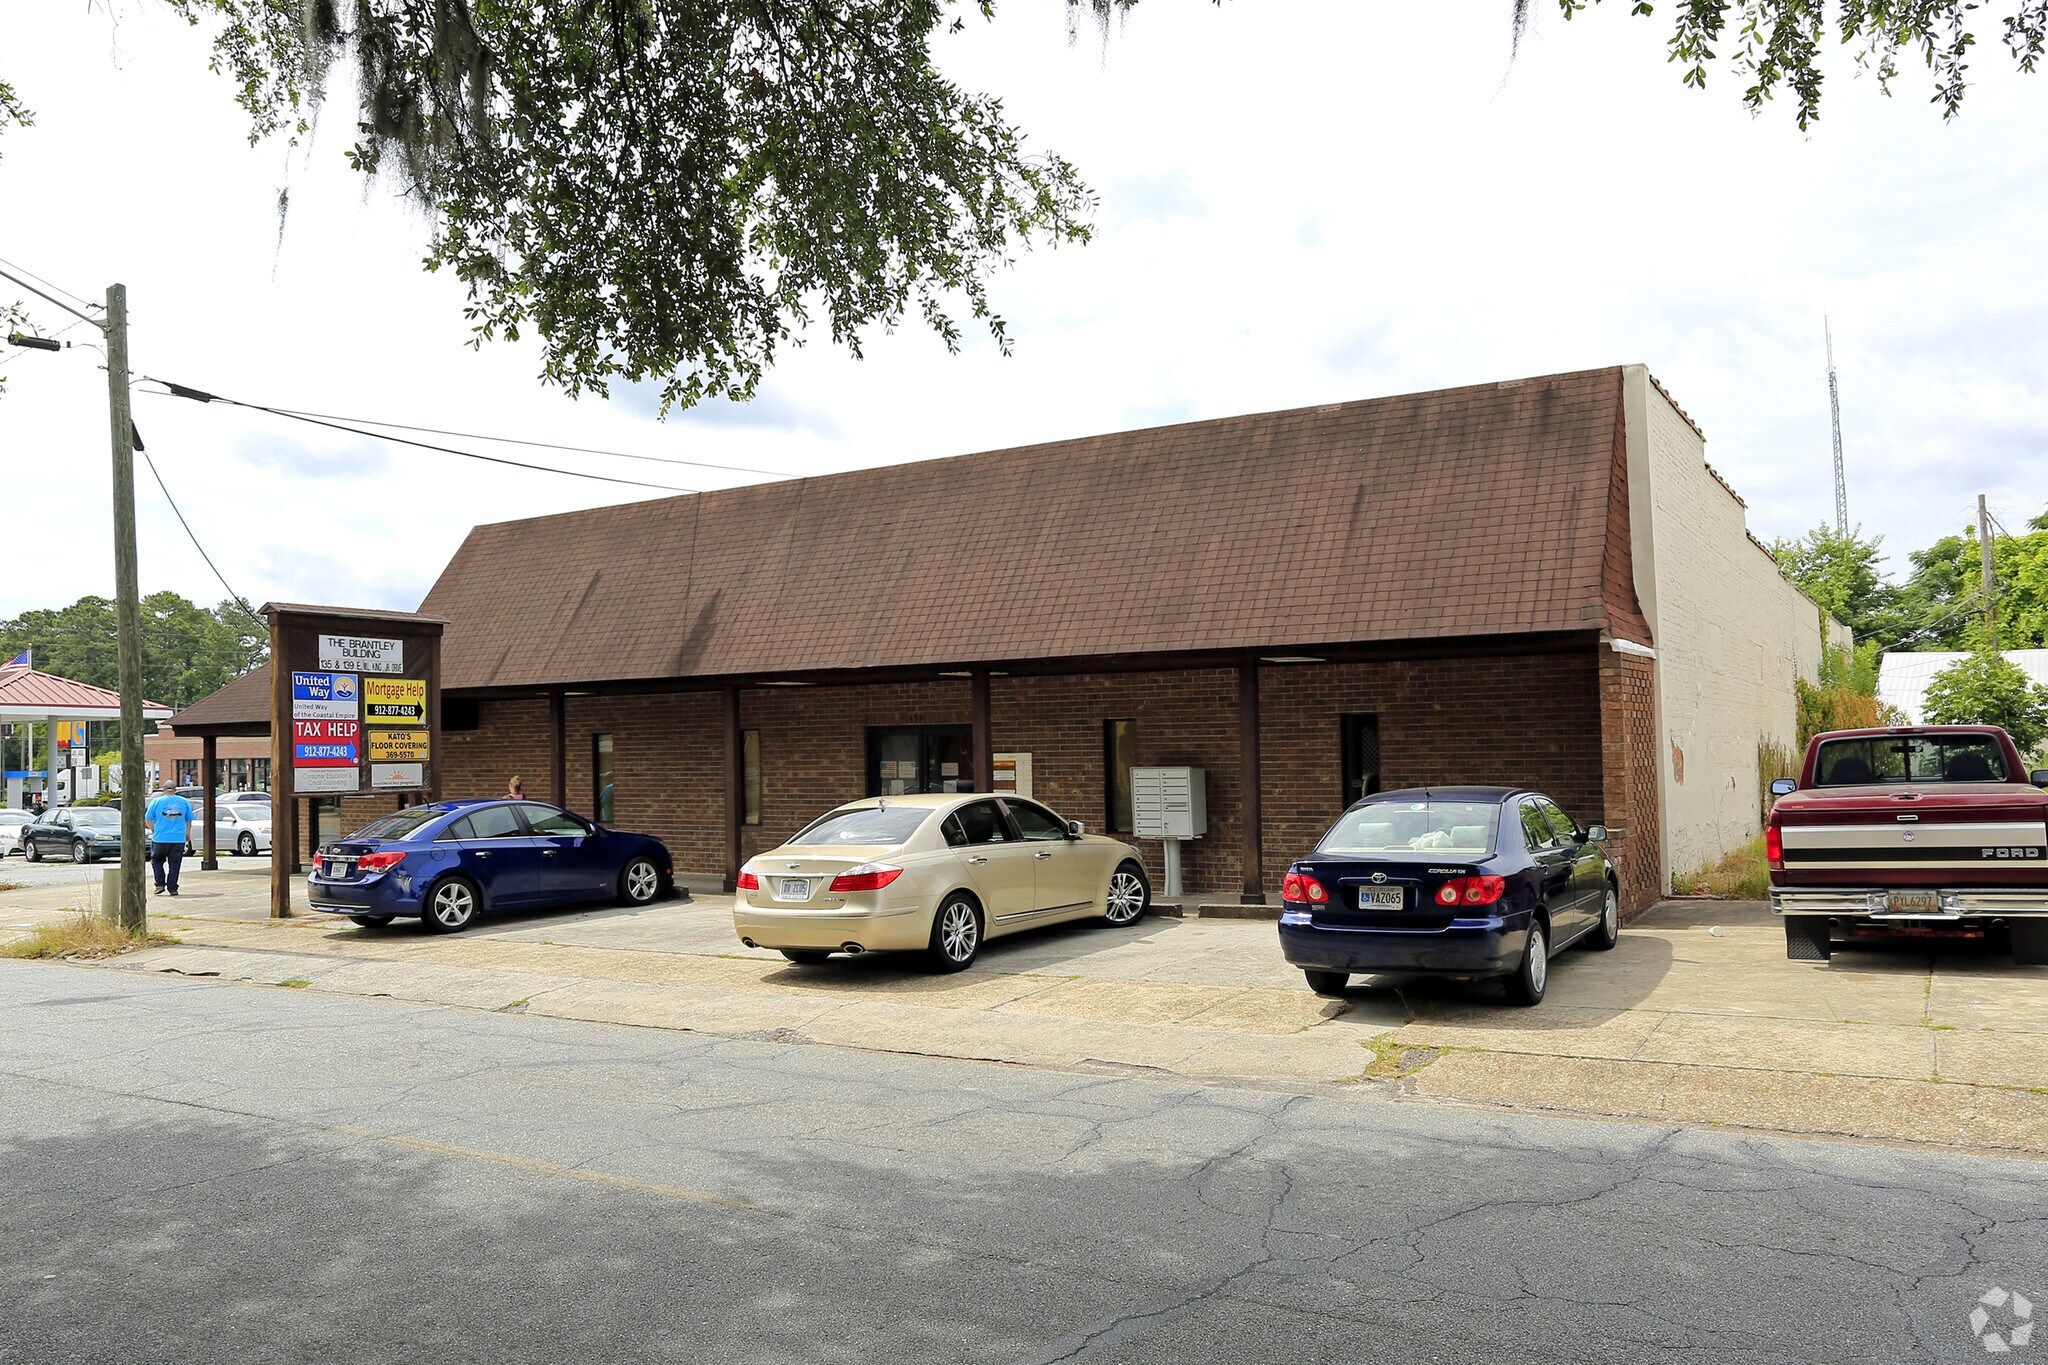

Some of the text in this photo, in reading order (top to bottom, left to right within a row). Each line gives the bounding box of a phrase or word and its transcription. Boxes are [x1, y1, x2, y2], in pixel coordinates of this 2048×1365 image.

[327, 638, 395, 650] THE BRANTLEY
[342, 648, 381, 659] BUILDING
[320, 660, 332, 668] 135
[335, 661, 340, 669] &
[343, 661, 354, 670] 139
[294, 676, 330, 686] United
[309, 686, 330, 700] Way
[367, 681, 424, 700] Mortgage Help
[374, 705, 415, 715] 912-877-4243
[296, 722, 357, 737] TAX HELP
[304, 746, 347, 756] 912-877-4243
[1982, 848, 2039, 858] FORD
[1893, 896, 1932, 907] PYL6297
